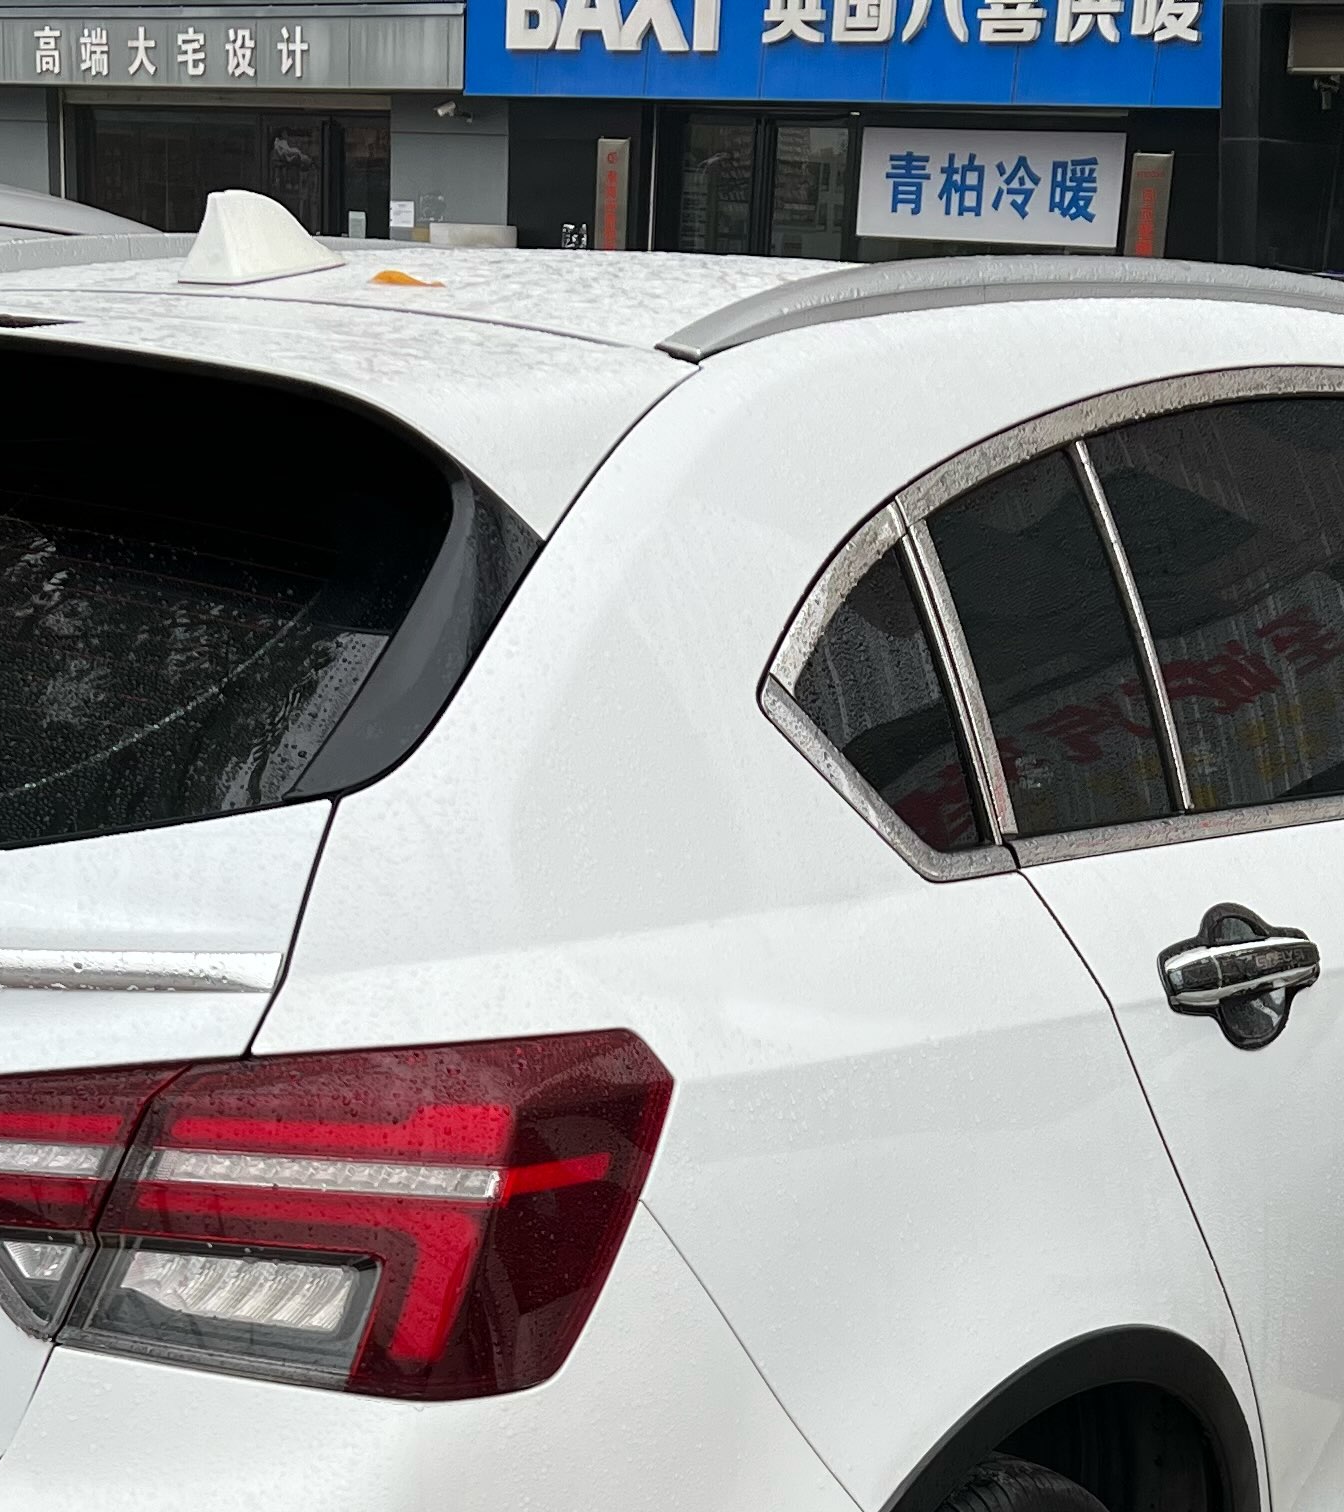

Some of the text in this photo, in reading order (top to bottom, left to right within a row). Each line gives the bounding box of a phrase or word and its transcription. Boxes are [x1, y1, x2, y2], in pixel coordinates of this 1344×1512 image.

[33, 25, 309, 78] 高端大宅设计
[884, 151, 1099, 223] 青柏冷暖
